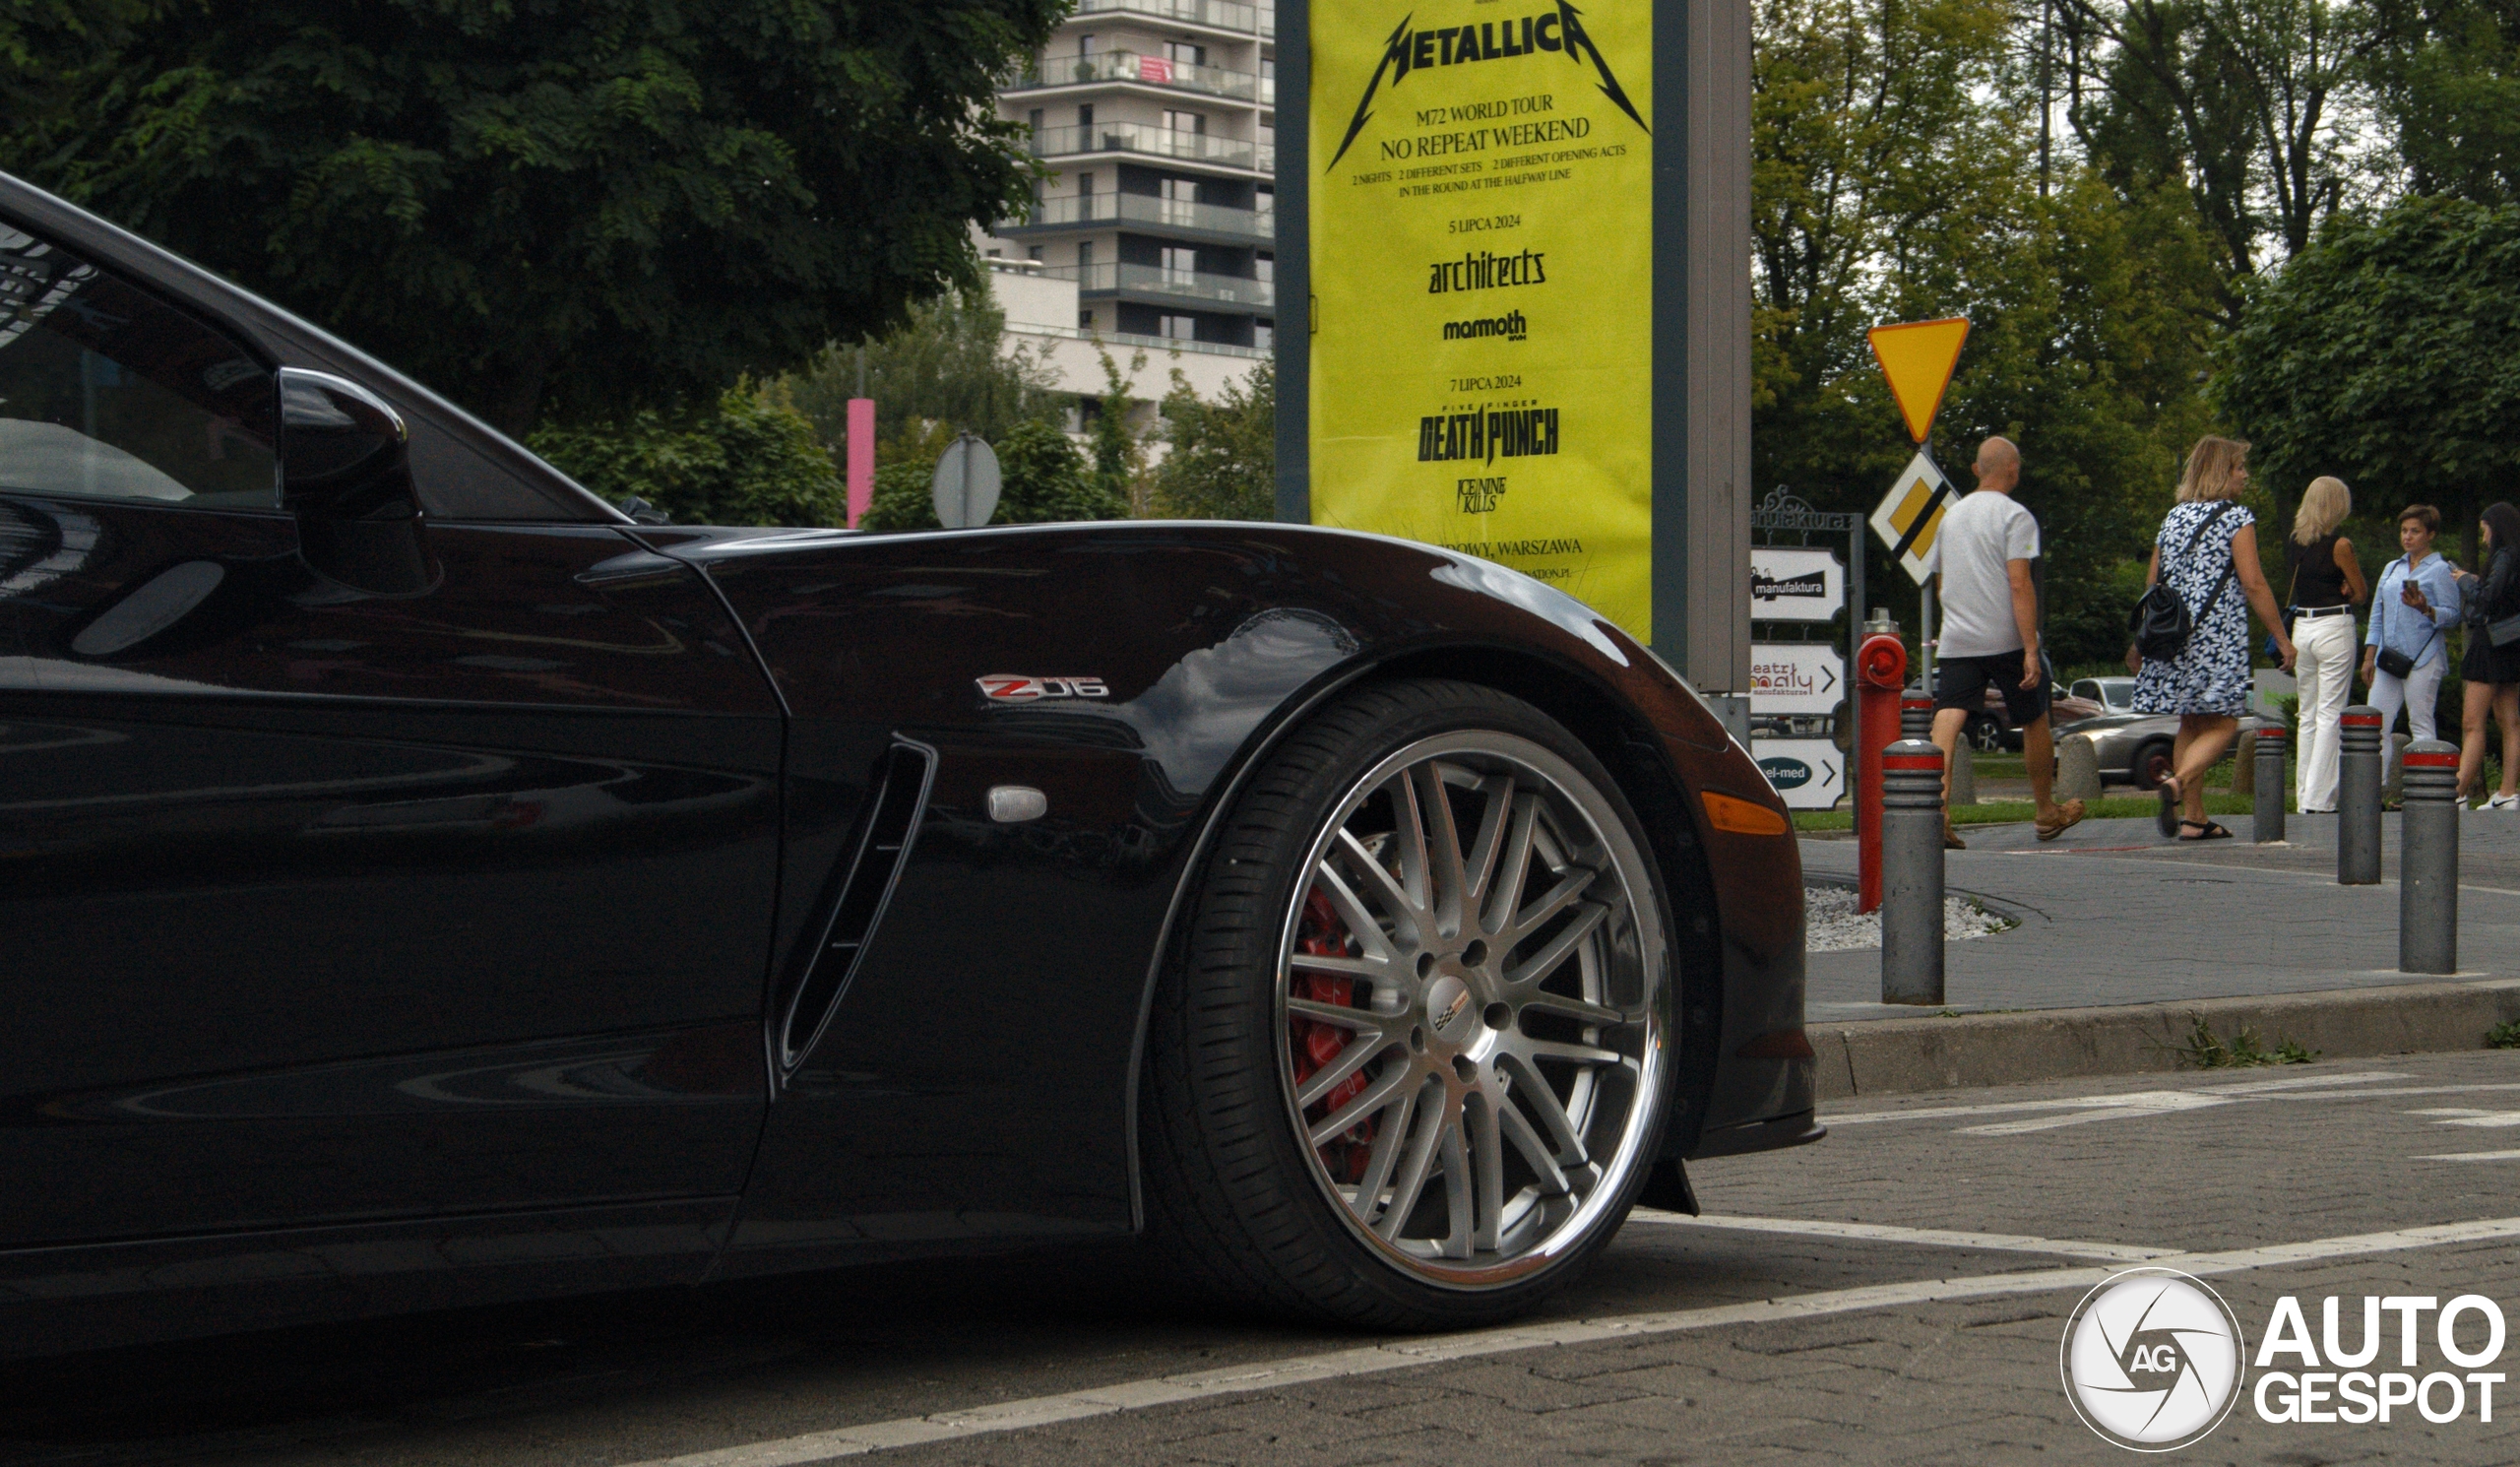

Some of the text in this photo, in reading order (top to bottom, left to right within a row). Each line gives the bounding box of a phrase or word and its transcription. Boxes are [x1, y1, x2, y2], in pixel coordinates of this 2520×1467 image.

[1326, 0, 1653, 174] METALLICA
[1417, 95, 1553, 127] M72 WORLD TOUR
[1380, 117, 1590, 160] NO REPEAT WEEKEND
[1353, 145, 1626, 185] 2 NIGHTS 2 DIFFERENT SETS 2 DIFFERENT OPENING ACTS
[1399, 168, 1571, 197] IN THE ROUND AT THE HALFWAY LINE
[1449, 214, 1521, 233] 5 LIPCA 2024
[1428, 248, 1545, 293] architects
[1443, 309, 1526, 340] mammoth
[1450, 375, 1521, 392] 7 LIPCA 2024
[1442, 399, 1538, 413] FIVE FINGER
[1418, 404, 1558, 468] DEATH PUNCH
[1456, 477, 1507, 502] ICE NINE
[1462, 494, 1497, 514] KILLS
[1440, 539, 1583, 559] OWY, WARSZAWA
[1755, 581, 1822, 594] manufaktura
[1751, 663, 1789, 673] eatr
[976, 674, 1109, 703] Z06
[1765, 767, 1805, 778] el-med
